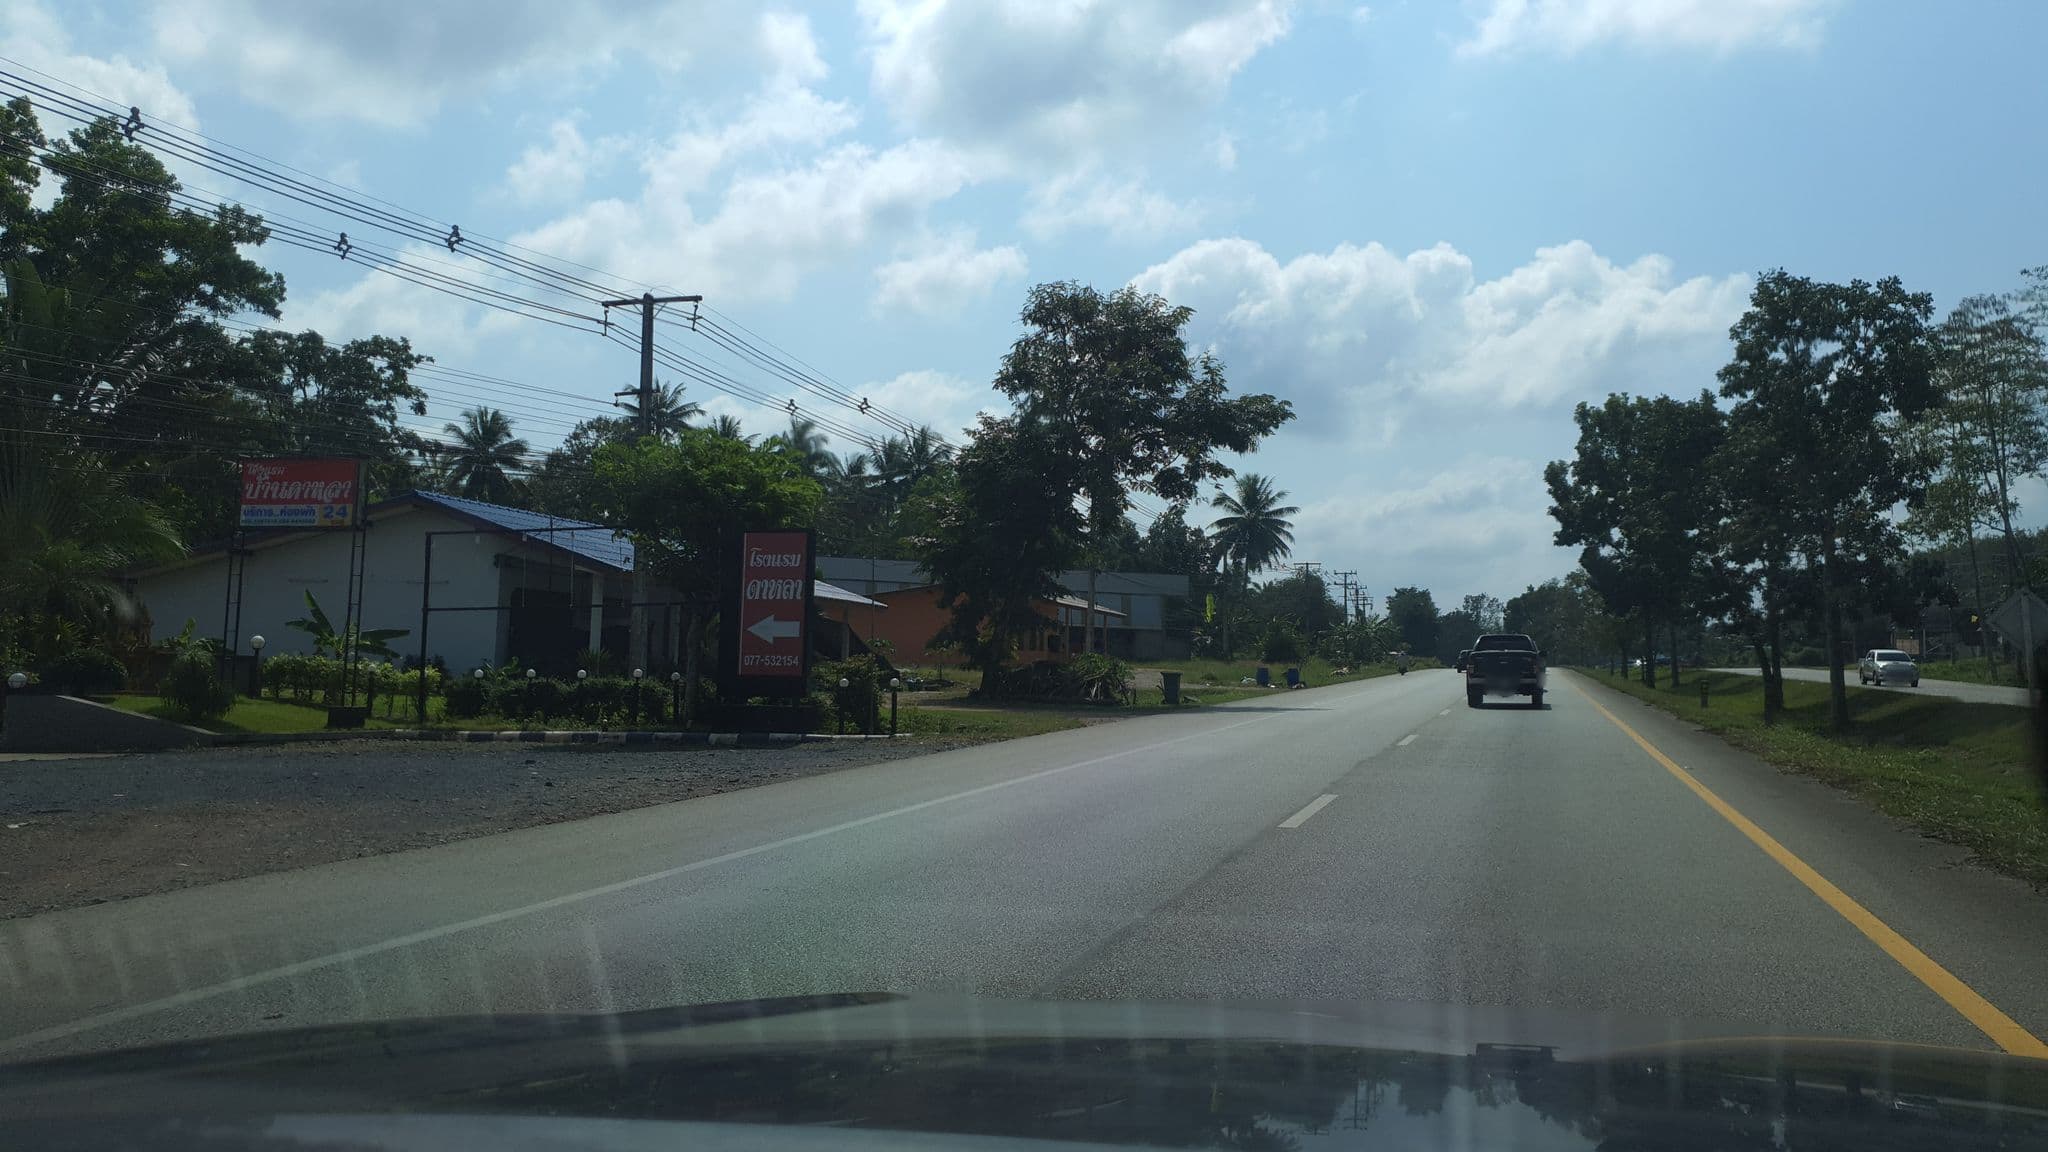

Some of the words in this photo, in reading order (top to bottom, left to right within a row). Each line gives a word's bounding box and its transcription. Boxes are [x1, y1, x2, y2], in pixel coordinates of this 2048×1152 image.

[323, 505, 348, 519] 24
[750, 547, 801, 567] โรงแรม
[747, 578, 803, 600] ดาหลา
[744, 655, 799, 666] 077-532154
